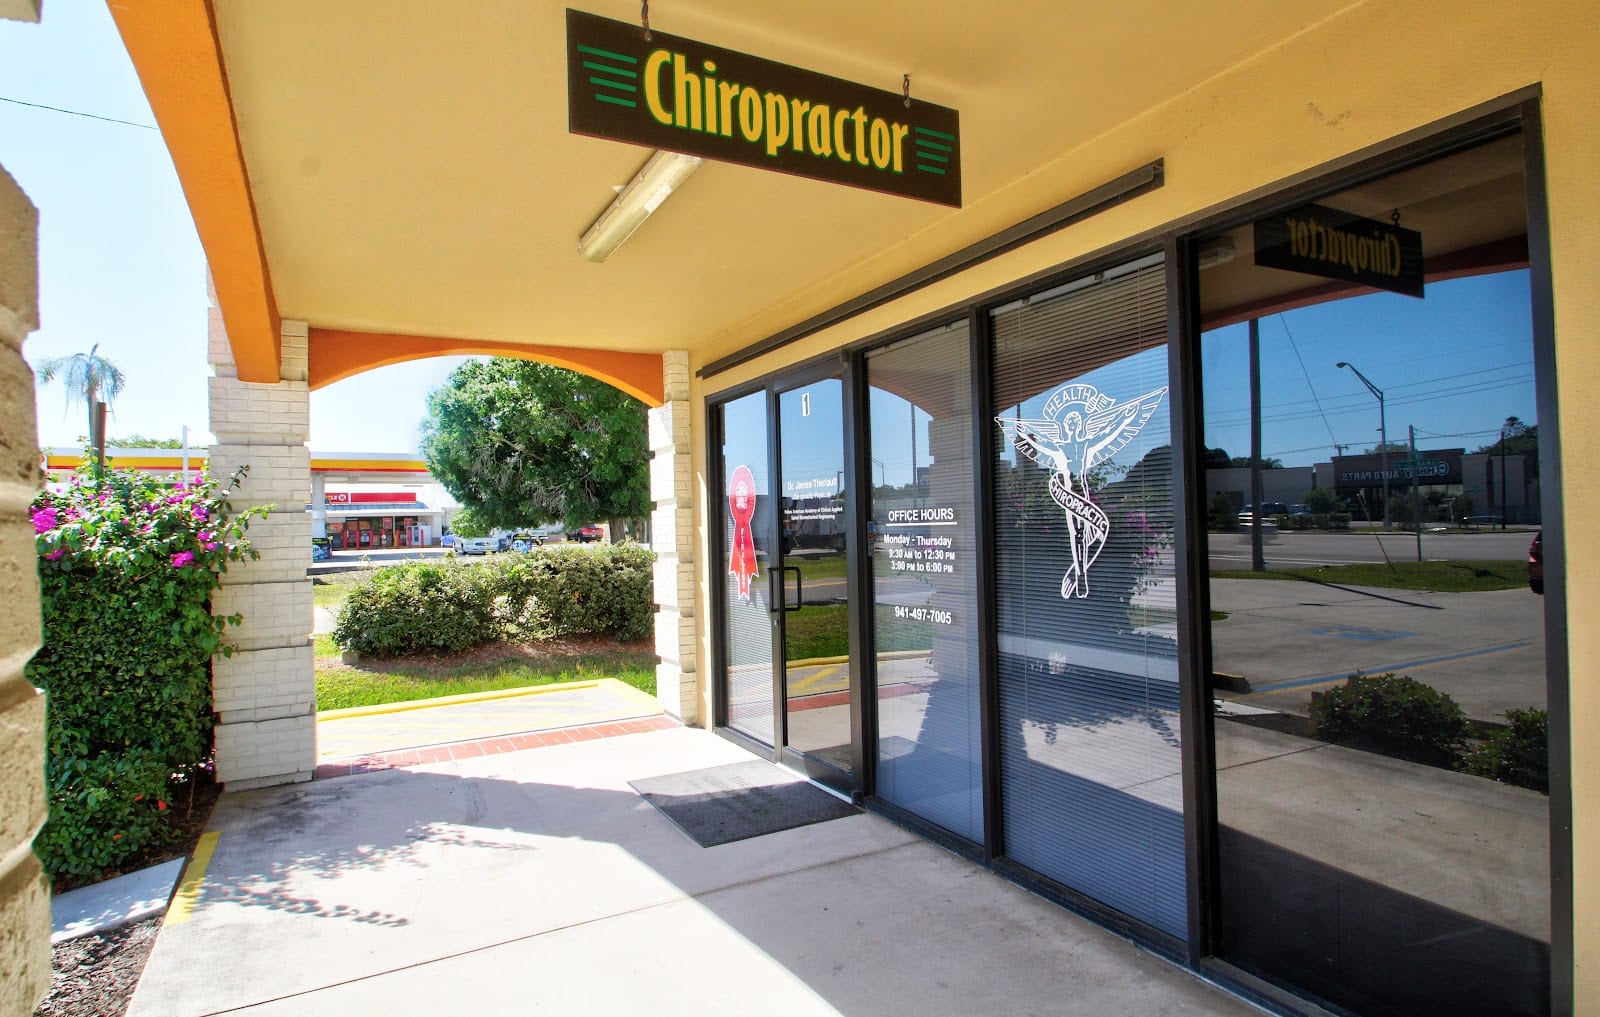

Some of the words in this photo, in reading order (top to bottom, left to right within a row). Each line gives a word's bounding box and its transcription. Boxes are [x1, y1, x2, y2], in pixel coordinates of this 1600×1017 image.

[643, 49, 909, 173] Chiropractor
[802, 392, 811, 416] 1
[1046, 386, 1092, 416] HEALTH
[888, 509, 919, 521] OFFICE
[920, 507, 954, 521] HOURS
[1049, 479, 1107, 531] CHIROPRACTIC
[883, 534, 911, 546] Monday
[916, 535, 952, 548] Thursday
[888, 548, 903, 559] 9:30
[904, 551, 913, 559] AM
[914, 550, 922, 559] to
[924, 549, 944, 560] 12:30
[945, 551, 956, 560] PM
[891, 560, 906, 571] 3:00
[906, 563, 915, 571] PM
[916, 562, 925, 572] to
[926, 562, 942, 573] 6:00
[943, 564, 954, 573] PM
[894, 605, 952, 625] 941-497-7005
